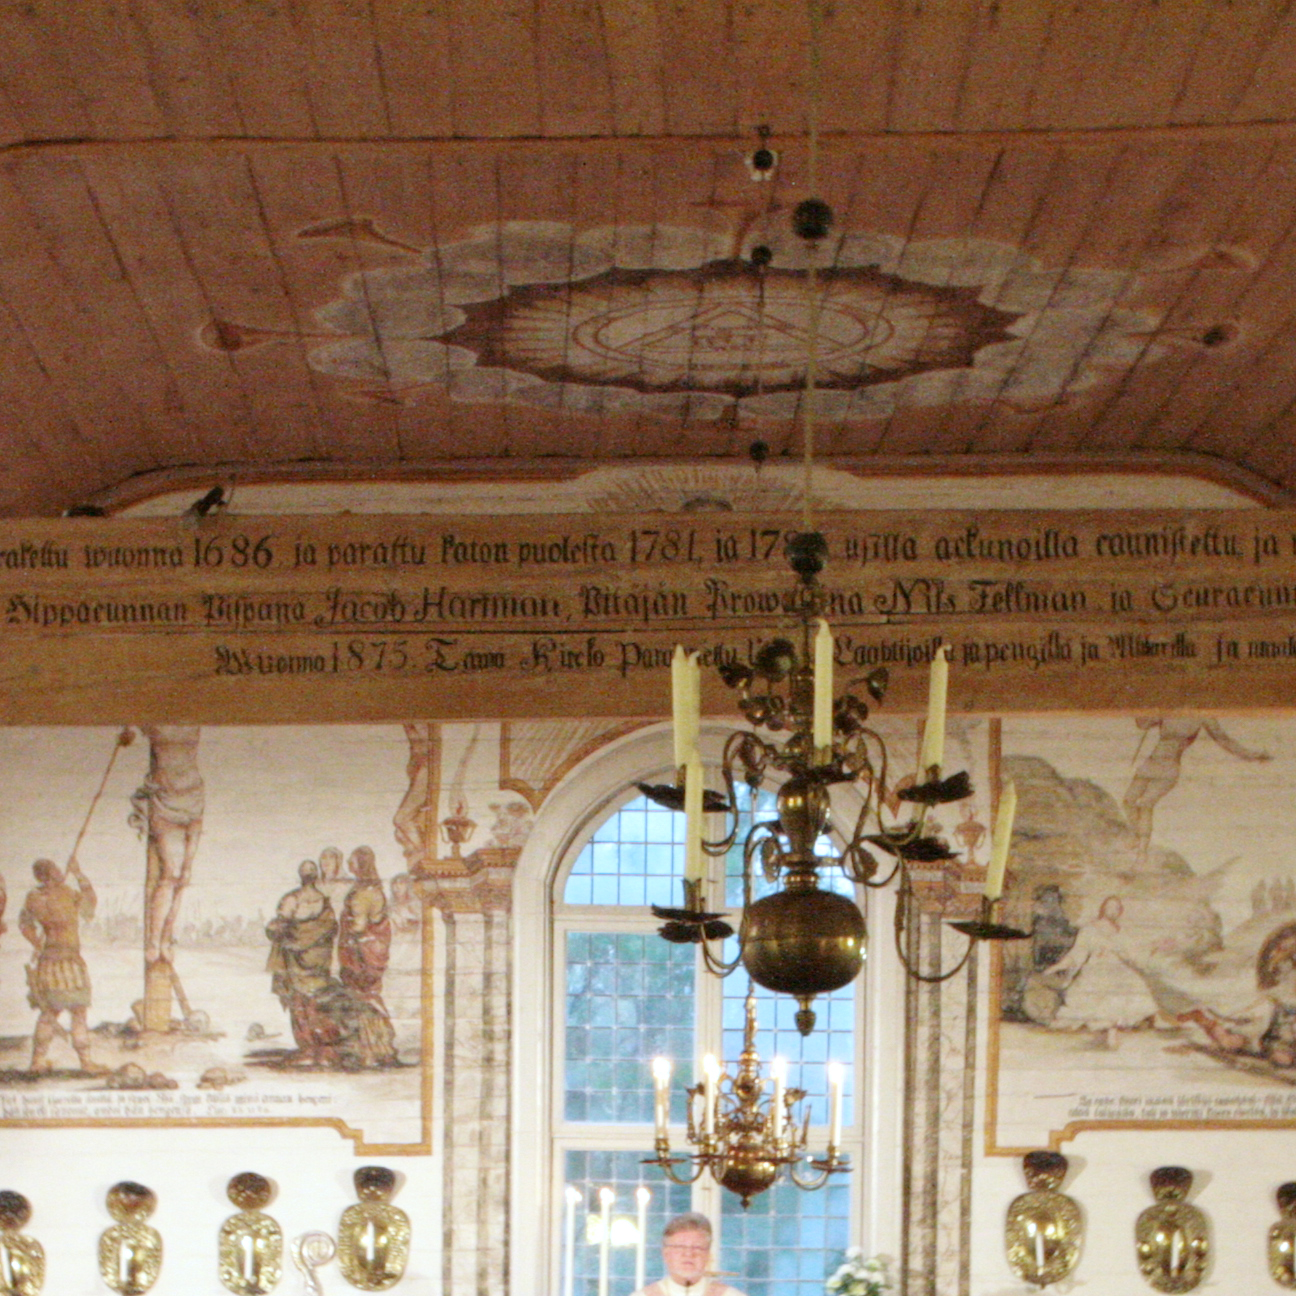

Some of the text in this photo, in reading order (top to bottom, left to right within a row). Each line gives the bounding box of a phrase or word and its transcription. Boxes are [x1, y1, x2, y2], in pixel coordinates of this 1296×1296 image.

[294, 538, 318, 569] ja
[715, 529, 739, 563] ja
[1255, 527, 1279, 564] ja
[1111, 587, 1134, 613] ja
